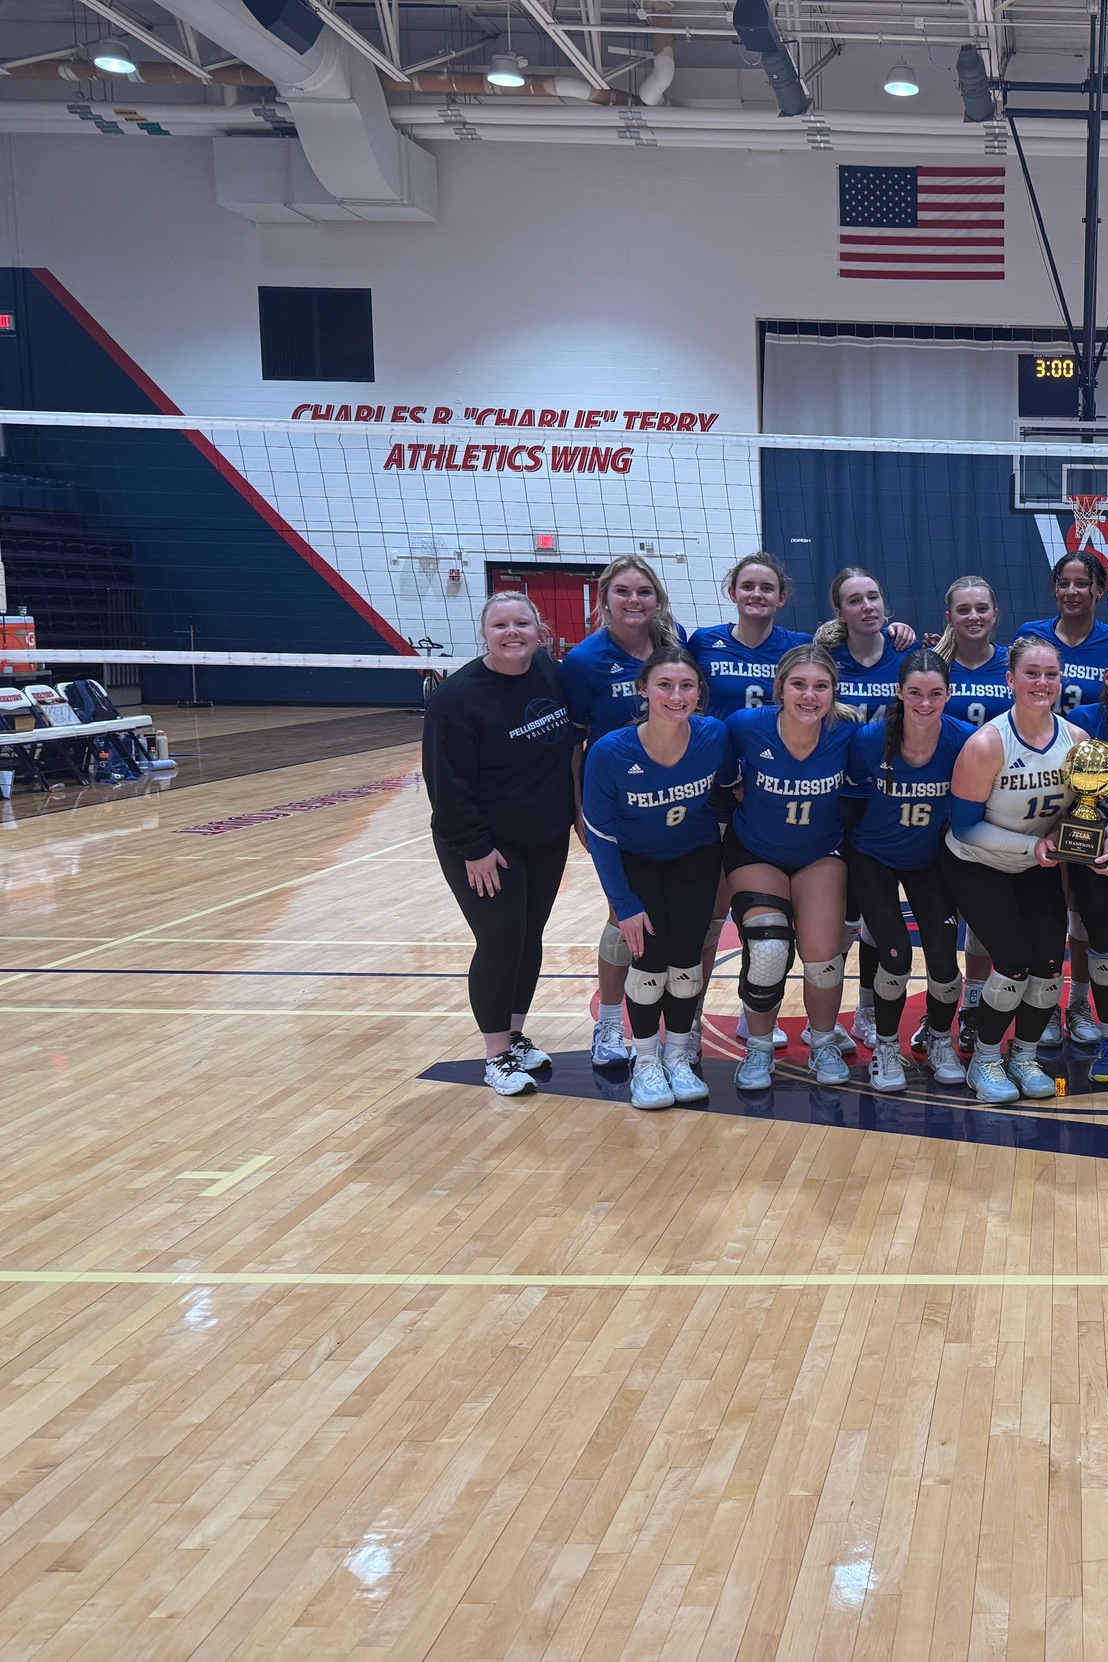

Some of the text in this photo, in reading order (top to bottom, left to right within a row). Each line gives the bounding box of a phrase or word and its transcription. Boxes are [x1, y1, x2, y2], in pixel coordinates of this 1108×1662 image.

[1036, 359, 1074, 378] 3:00
[623, 411, 720, 432] TERRY
[383, 443, 635, 474] ATHLETICS WING
[710, 661, 779, 679] PELLISSI
[745, 684, 764, 709] 6
[836, 681, 900, 697] ELLISSI
[949, 683, 1014, 700] LLISSIPP
[508, 713, 556, 739] PELLISSIPPI
[967, 702, 986, 729] 9
[526, 716, 570, 740] VOLLEYBALL
[626, 770, 717, 808] PELLISSIPP
[1000, 769, 1065, 791] PELLISSI
[665, 805, 688, 828] 8
[785, 801, 813, 826] 11
[898, 803, 932, 828] 16
[1023, 793, 1065, 820] 15
